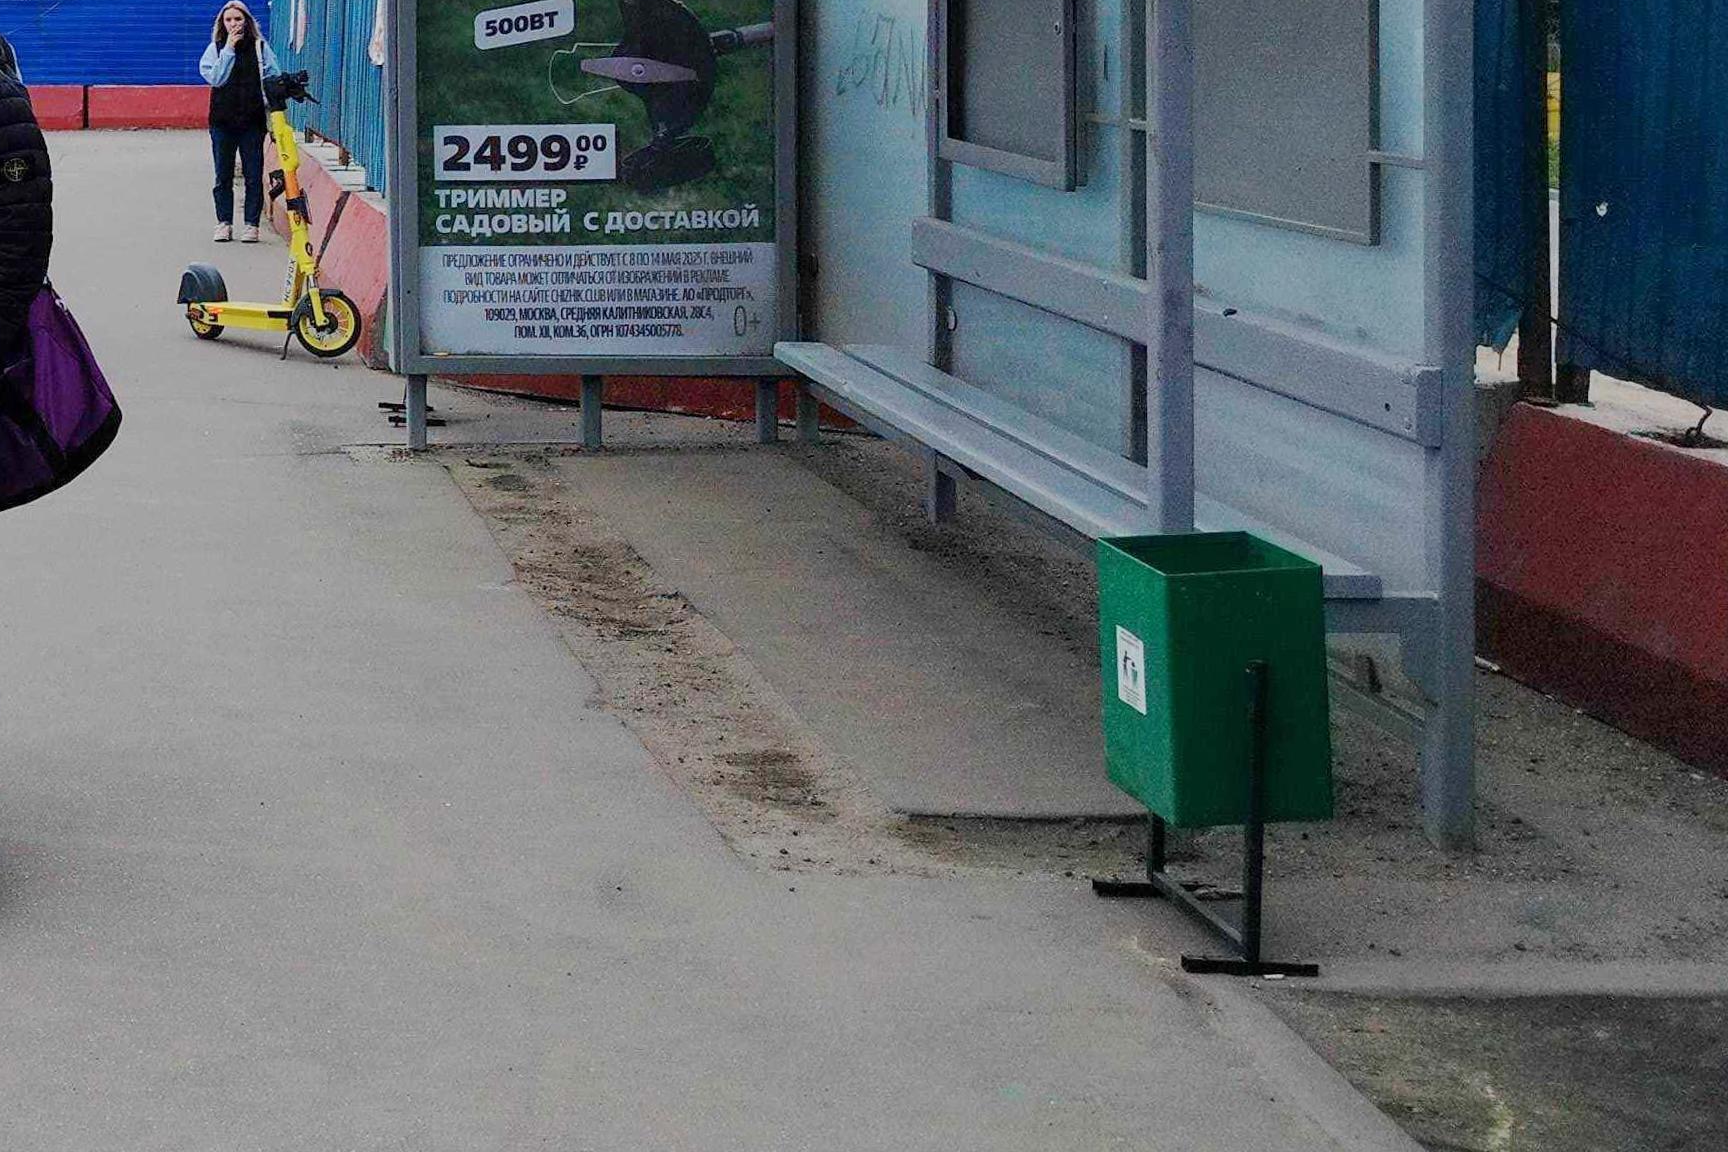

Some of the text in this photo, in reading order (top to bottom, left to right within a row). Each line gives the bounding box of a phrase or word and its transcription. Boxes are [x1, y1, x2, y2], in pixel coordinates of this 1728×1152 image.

[443, 134, 571, 172] 2499
[434, 189, 567, 209] ТРИММЕР
[435, 204, 759, 237] САДОВЫЙ С ДОСТАВКОЙ
[443, 254, 508, 268] ПРЕДЛОЖЕНИЕ
[508, 254, 564, 267] ОГРАНИЧЕНО
[566, 254, 572, 266] И
[574, 250, 620, 269] ДЕЙСТВУЕТ
[622, 252, 628, 266] С
[637, 252, 650, 266] ПО
[662, 252, 682, 266] МАЯ
[710, 248, 753, 264] ВНЕШНИЙ
[464, 272, 483, 287] ВИД
[485, 272, 516, 285] ТОВАРА
[518, 272, 550, 285] МОЖЕТ
[550, 271, 604, 284] ОТЛИЧАТЬСЯ
[606, 271, 616, 284] ОТ
[684, 270, 690, 283] В
[444, 290, 508, 304] ПОДРОБНОСТИ
[510, 290, 521, 303] НА
[522, 288, 550, 303] САЙТЕ
[607, 289, 626, 302] ИЛИ
[627, 289, 632, 302] В
[682, 288, 694, 301] АО
[484, 309, 518, 322] 109029,
[520, 308, 559, 322] МОСКВА,
[561, 308, 601, 322] СРЕДНЯЯ
[734, 306, 760, 336] 0+
[590, 325, 614, 338] ОГРН
